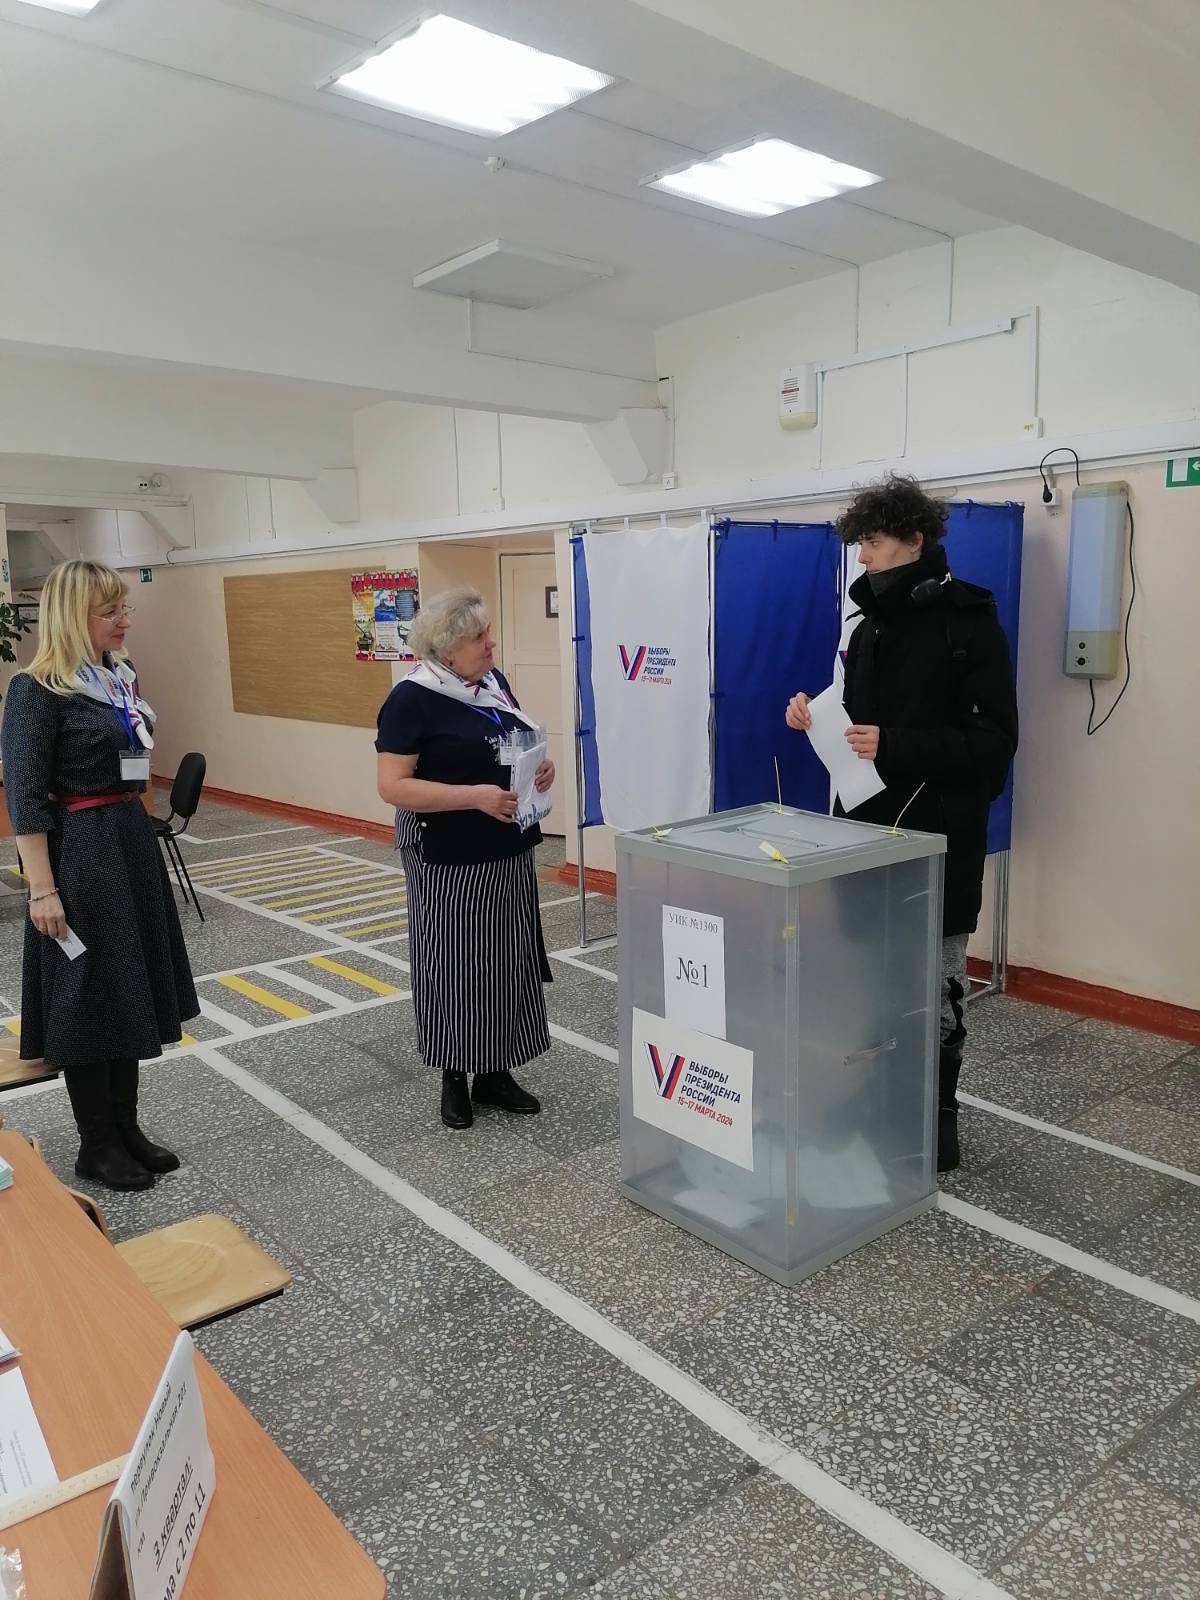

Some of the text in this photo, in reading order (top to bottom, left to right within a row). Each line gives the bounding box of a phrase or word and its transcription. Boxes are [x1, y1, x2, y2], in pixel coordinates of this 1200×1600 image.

[646, 656, 676, 666] ПРЕЗИДЕНТА
[648, 647, 671, 656] ВЫБОРЫ
[643, 666, 664, 675] РОССИИ
[669, 912, 718, 934] УИК №1300
[676, 956, 710, 989] №1
[689, 1061, 729, 1084] ВЫБОРЫ
[681, 1085, 716, 1107] РОССИИ
[685, 1073, 741, 1104] ПРЕЗИДЕНТА
[694, 1104, 716, 1119] МАРТА
[716, 1113, 733, 1127] 2024
[154, 1380, 171, 1430] Новый
[194, 1482, 206, 1513] 11
[153, 1456, 193, 1566] 3 квартал:
[184, 1512, 196, 1544] по
[178, 1537, 187, 1561] 2
[175, 1556, 182, 1575] с
